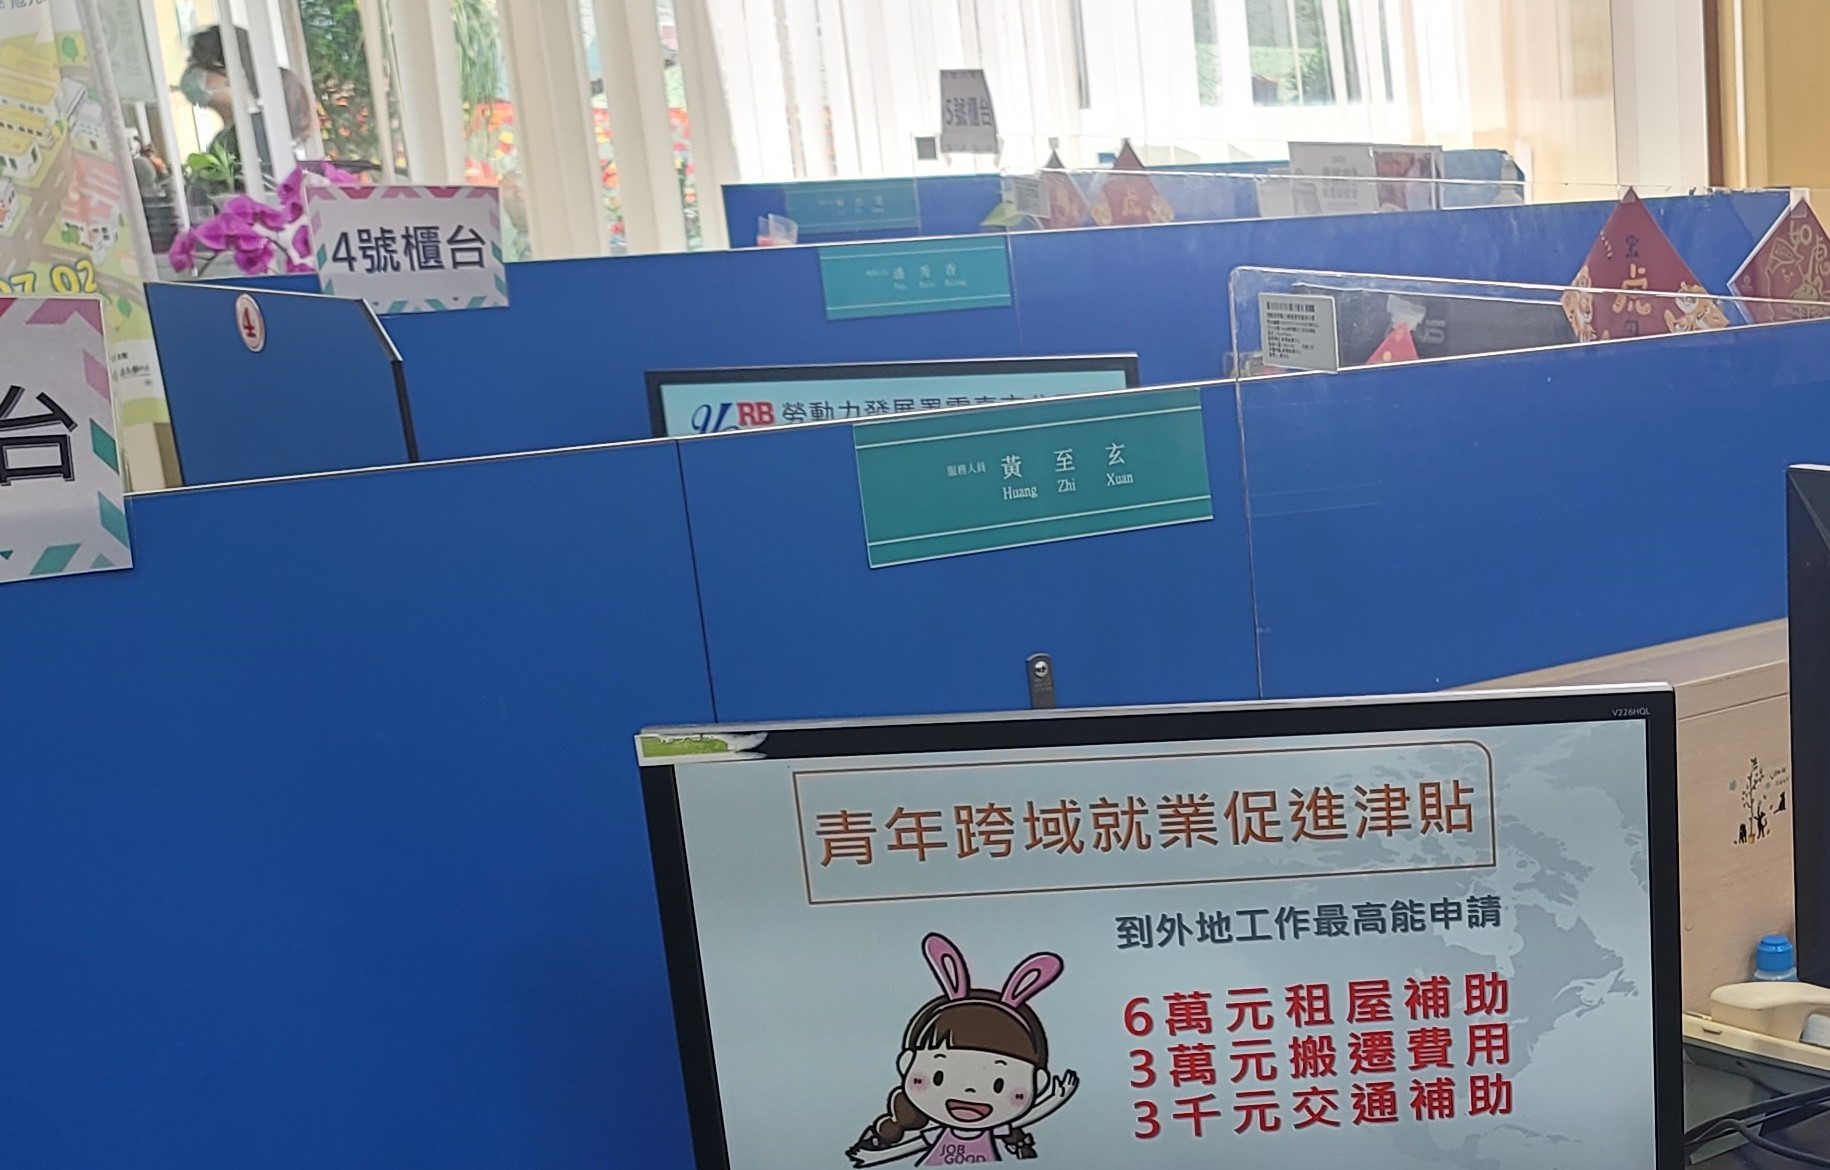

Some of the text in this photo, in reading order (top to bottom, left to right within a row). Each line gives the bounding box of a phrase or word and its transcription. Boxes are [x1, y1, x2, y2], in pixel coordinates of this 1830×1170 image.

[332, 224, 486, 273] 4號櫃台
[243, 307, 257, 338] 4
[947, 461, 987, 476] 服務人員
[1003, 472, 1134, 500] Huang Zhi Xuan
[1611, 707, 1651, 717] V226HQL
[815, 779, 1475, 867] 青年跨域就業促進津貼
[1115, 894, 1502, 950] 到外地工作最高能申請
[1123, 971, 1510, 1037] 6萬元租屋補助
[1129, 1023, 1511, 1089] 3萬元搬遷費用
[1134, 1073, 1513, 1140] 3千元交通補助
[940, 1144, 966, 1157] JOB
